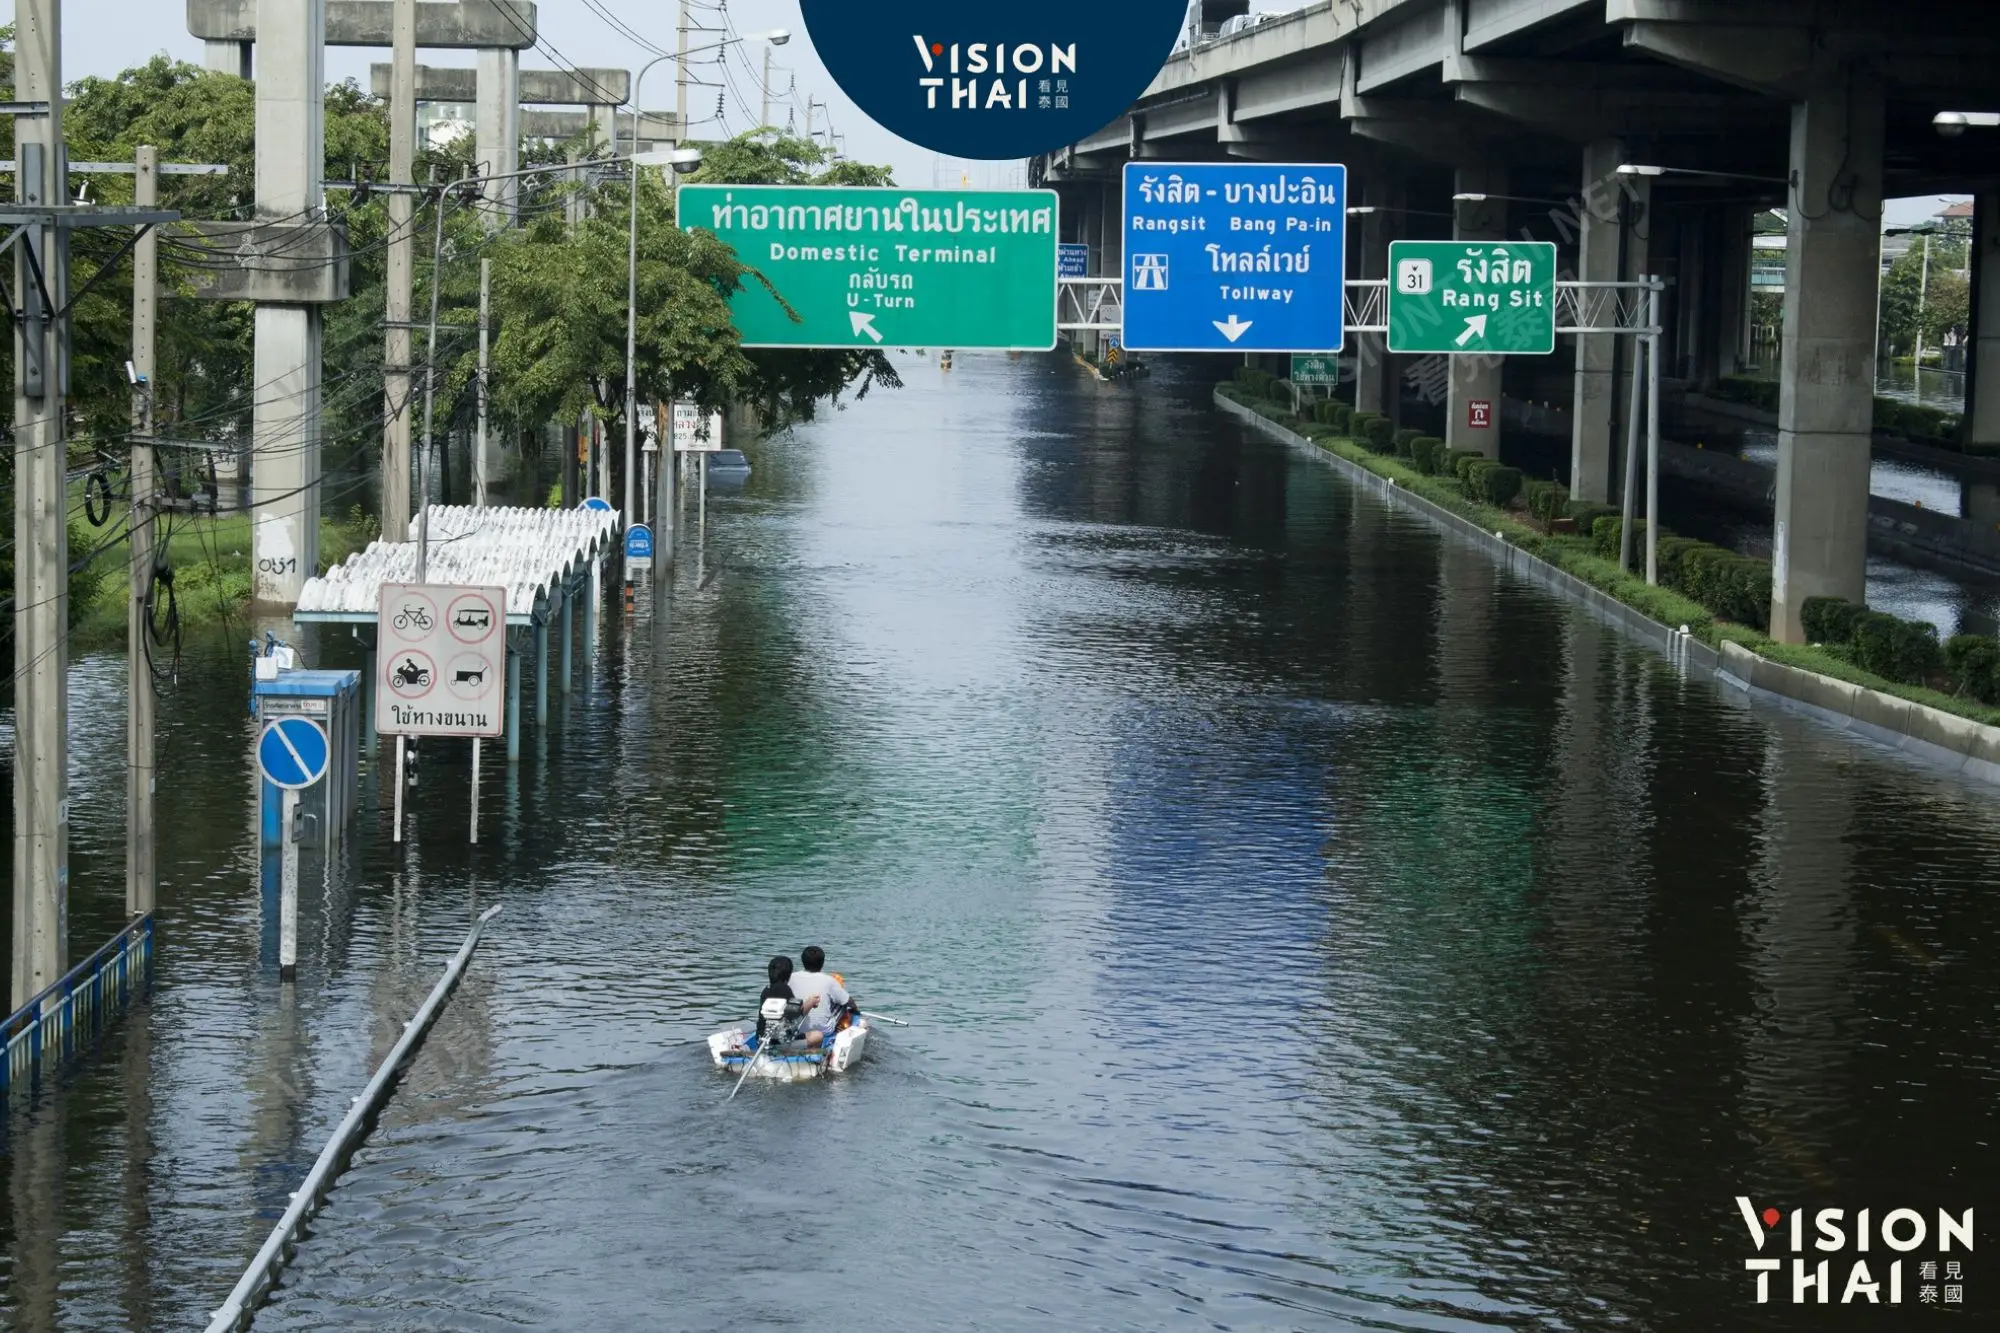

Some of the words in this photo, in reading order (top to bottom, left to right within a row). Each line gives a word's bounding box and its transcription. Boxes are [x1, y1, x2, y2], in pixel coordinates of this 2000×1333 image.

[1138, 174, 1201, 205] รังสิต
[1224, 174, 1337, 205] บางปะอิน
[711, 193, 1052, 235] ท่าอากาศยานในประเทศ
[1132, 216, 1207, 235] Rangsit
[1230, 217, 1277, 235] Bang
[1286, 217, 1332, 233] Pa-in
[769, 243, 880, 262] Domestic
[895, 244, 997, 264] Terminal
[1204, 243, 1312, 273] โทลล์เวย์
[848, 265, 914, 290] กลับรถ
[1456, 247, 1533, 285] รังสิต
[1407, 273, 1424, 290] 31
[1219, 286, 1294, 304] Tollway
[1442, 289, 1500, 312] Rang
[1508, 289, 1544, 308] Sit
[390, 704, 489, 728] ใช้ทางขนาน
